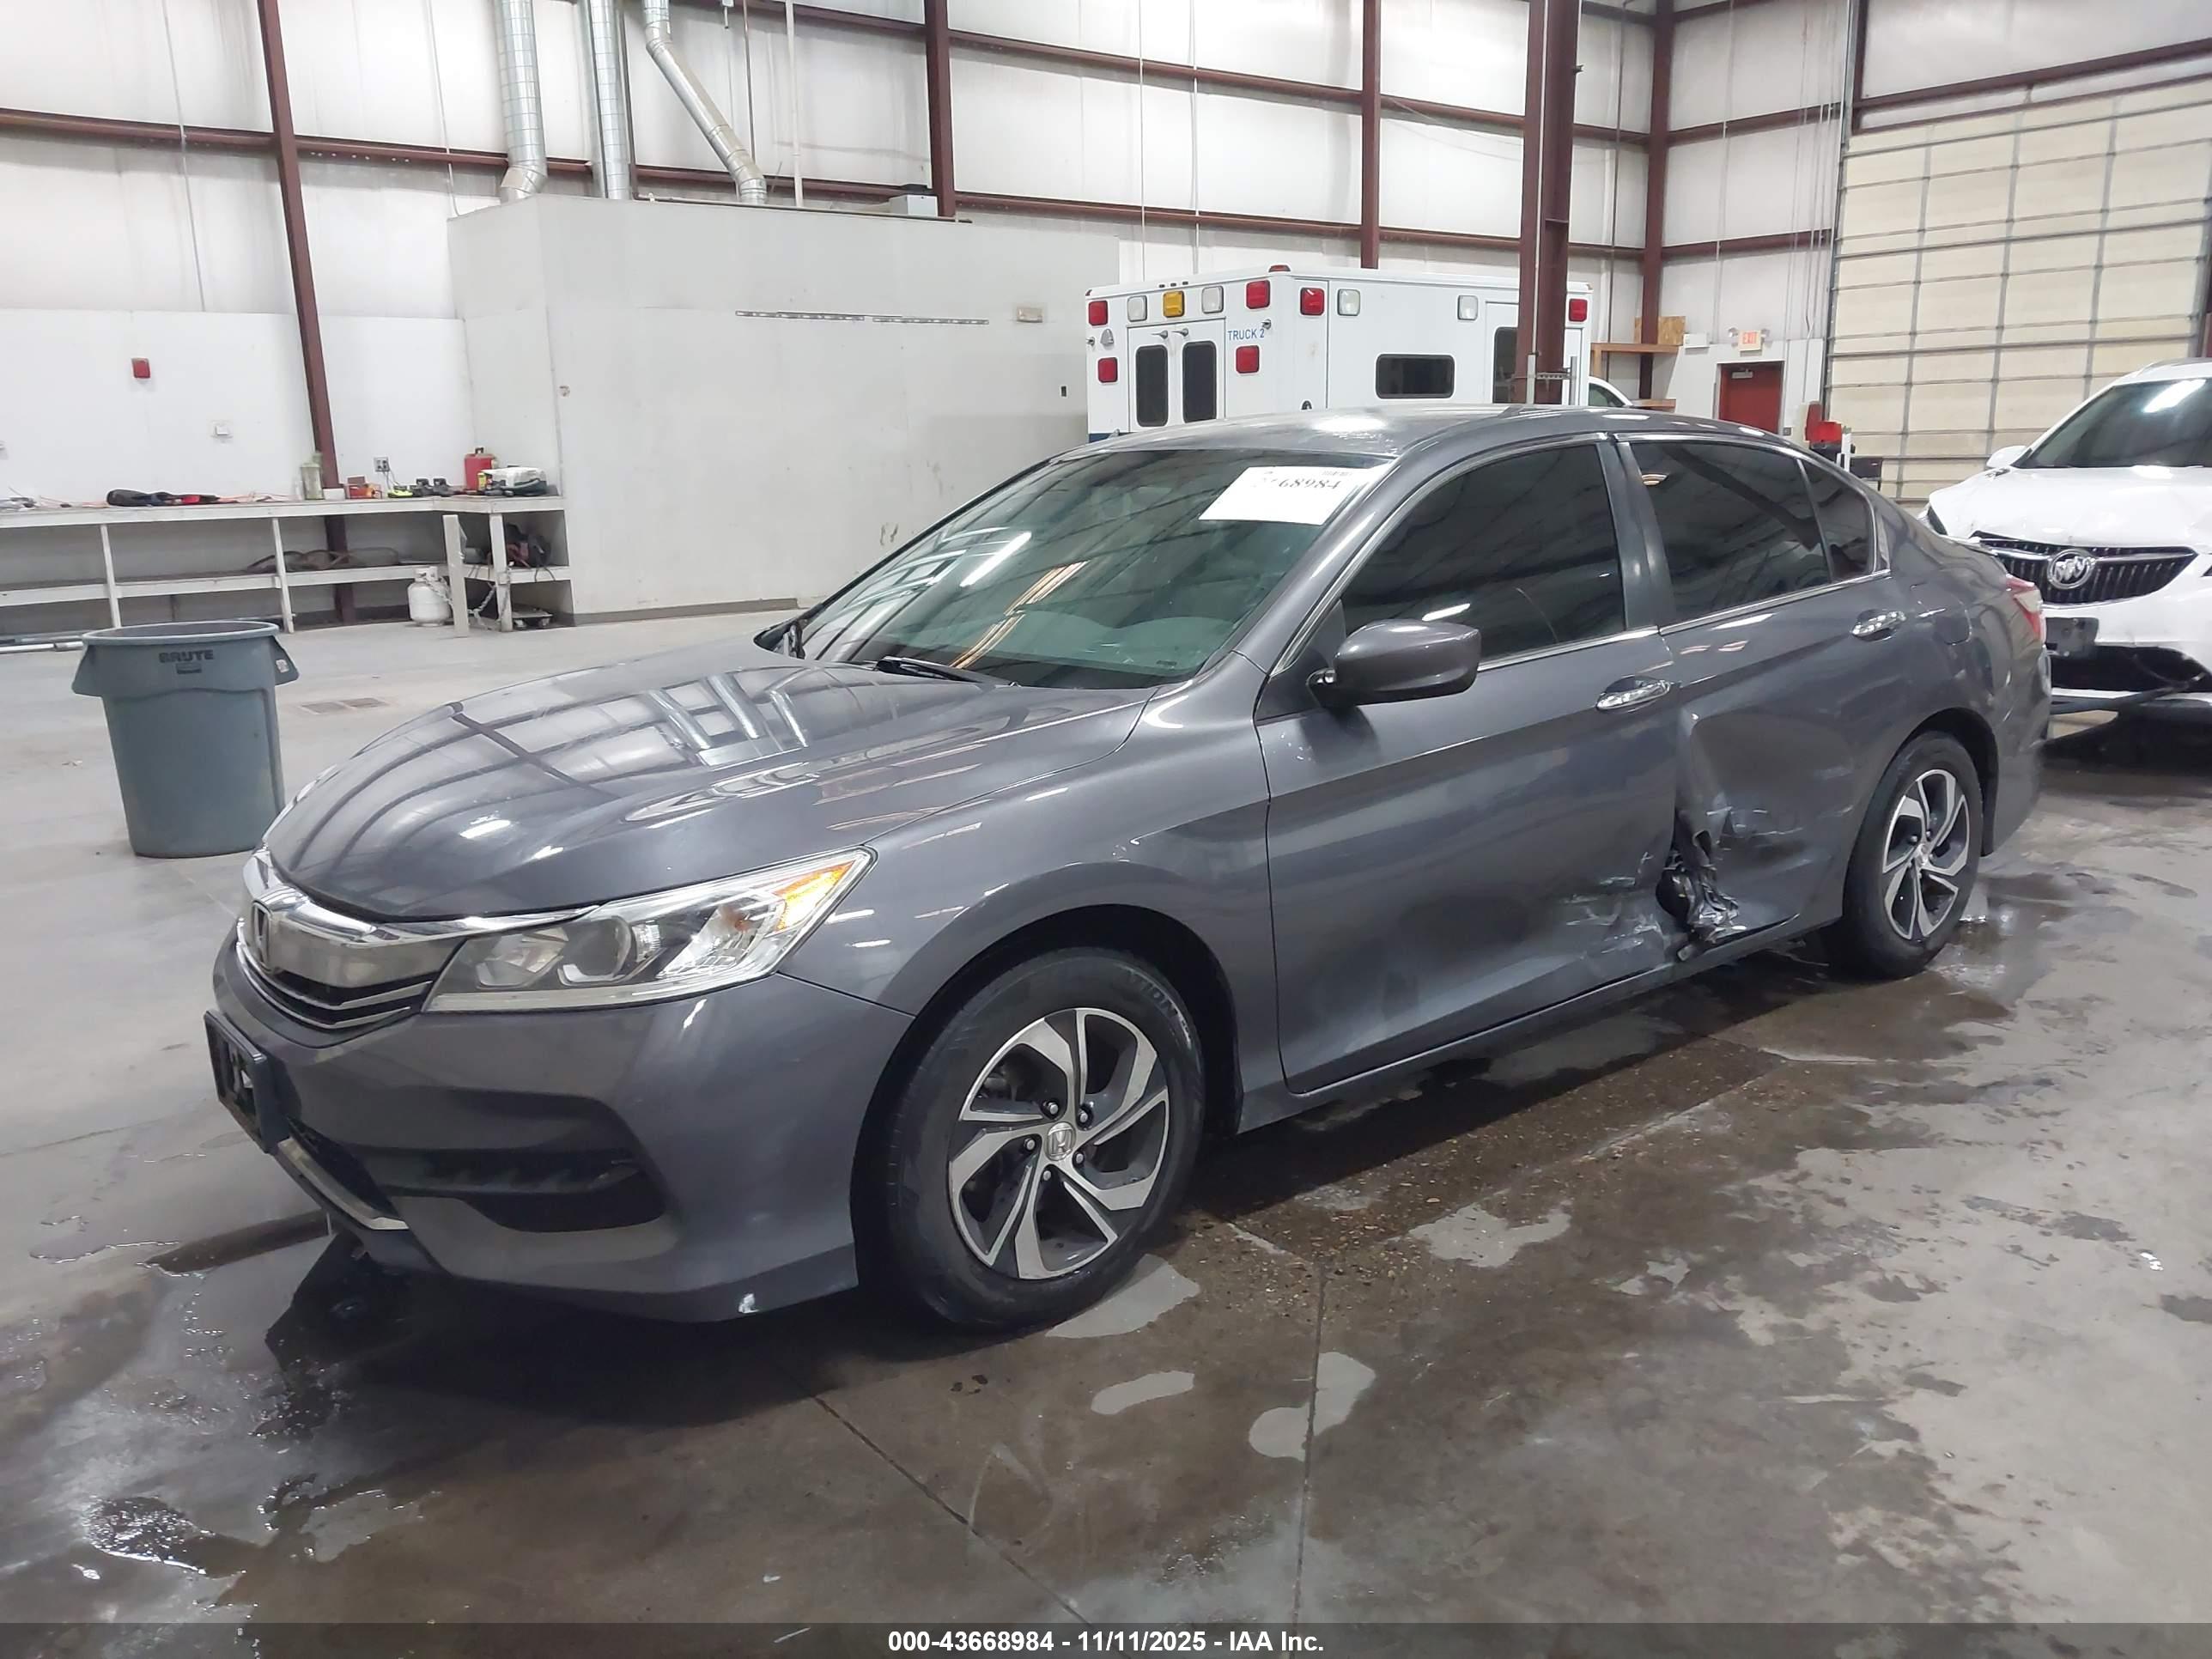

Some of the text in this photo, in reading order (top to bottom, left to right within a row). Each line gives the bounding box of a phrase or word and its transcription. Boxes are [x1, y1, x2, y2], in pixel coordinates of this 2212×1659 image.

[1227, 328, 1265, 340] TRUCK 2
[159, 649, 214, 663] BRUTE
